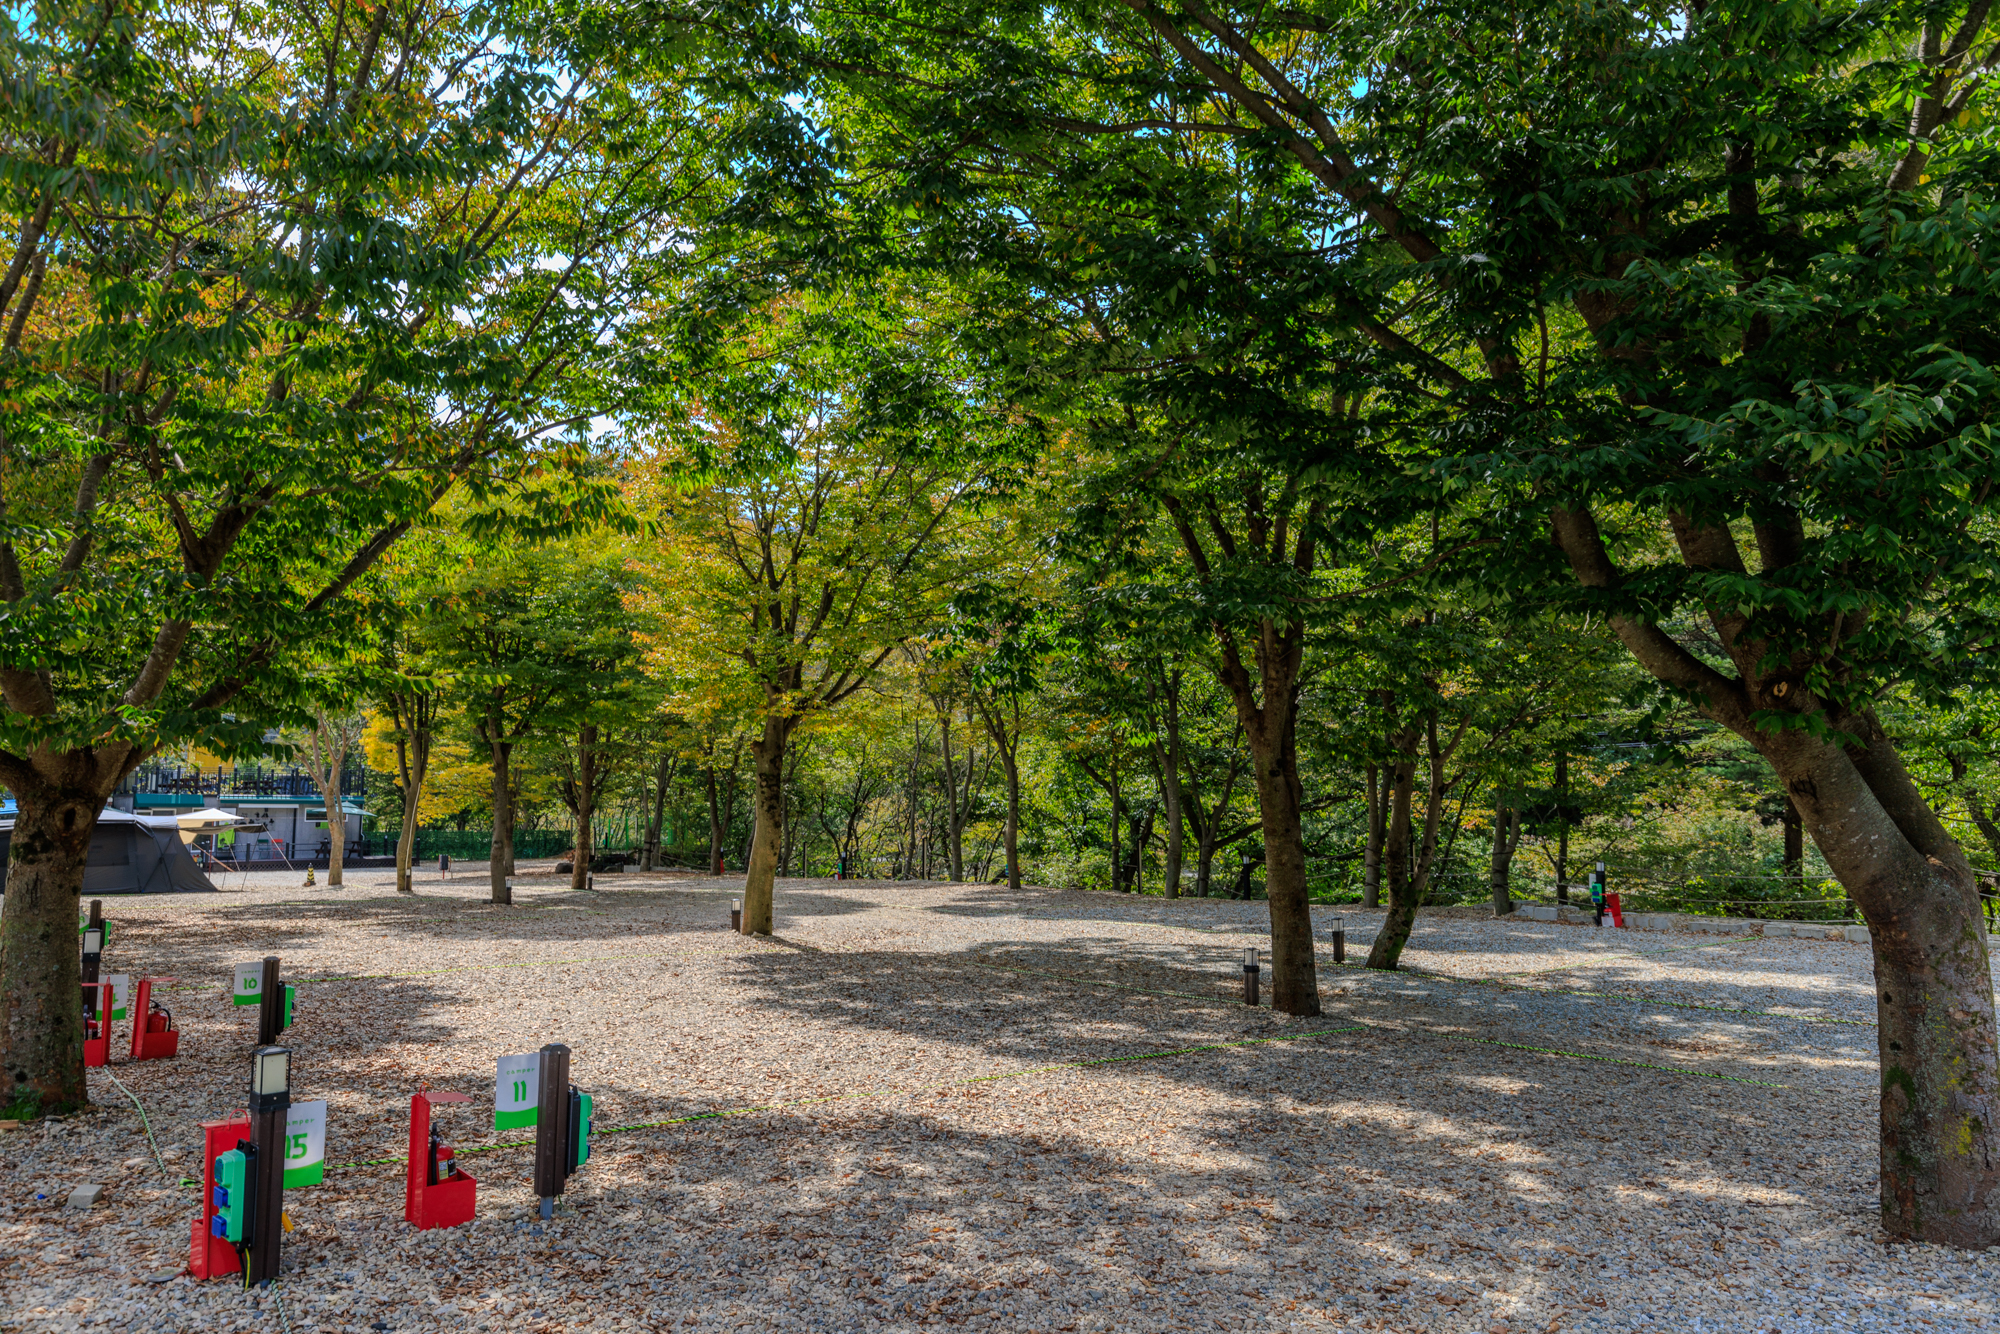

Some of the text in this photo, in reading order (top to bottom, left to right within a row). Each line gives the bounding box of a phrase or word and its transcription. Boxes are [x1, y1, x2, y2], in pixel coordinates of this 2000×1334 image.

[244, 977, 257, 990] 10
[513, 1080, 527, 1102] 11
[286, 1118, 315, 1127] amper
[285, 1133, 308, 1160] 15
